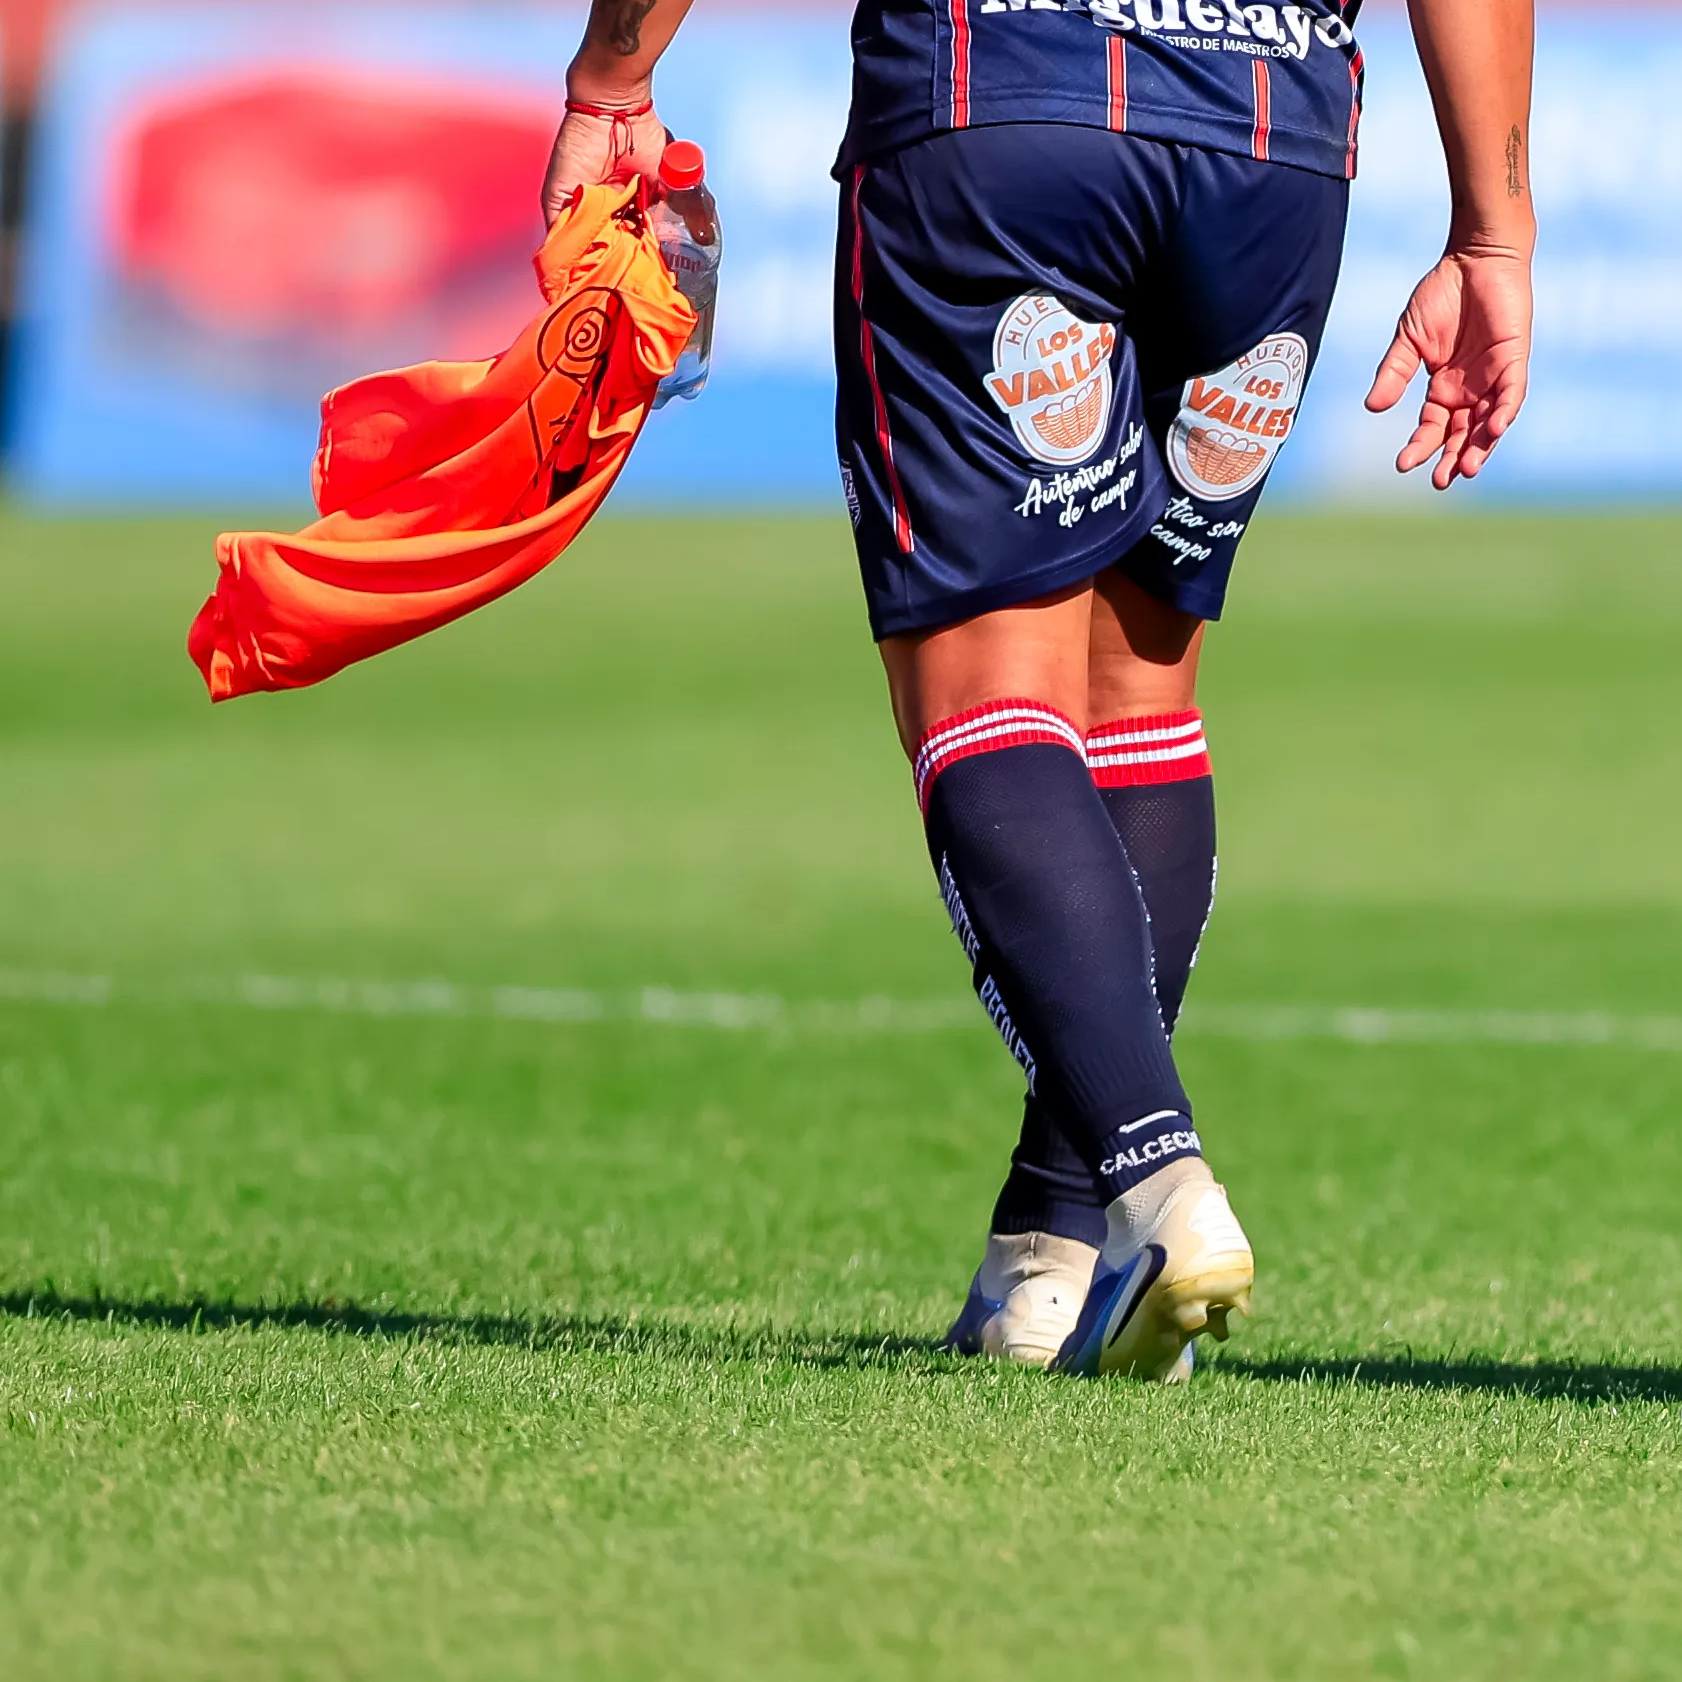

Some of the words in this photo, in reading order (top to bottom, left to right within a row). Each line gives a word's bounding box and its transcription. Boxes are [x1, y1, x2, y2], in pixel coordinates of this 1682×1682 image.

[1202, 38, 1220, 51] DE
[1223, 39, 1290, 59] MAESTROS
[1036, 321, 1085, 359] LOS
[990, 322, 1116, 408] VALLES
[1244, 375, 1285, 400] LOS
[1187, 377, 1296, 438] VALLES
[1058, 494, 1085, 529] de
